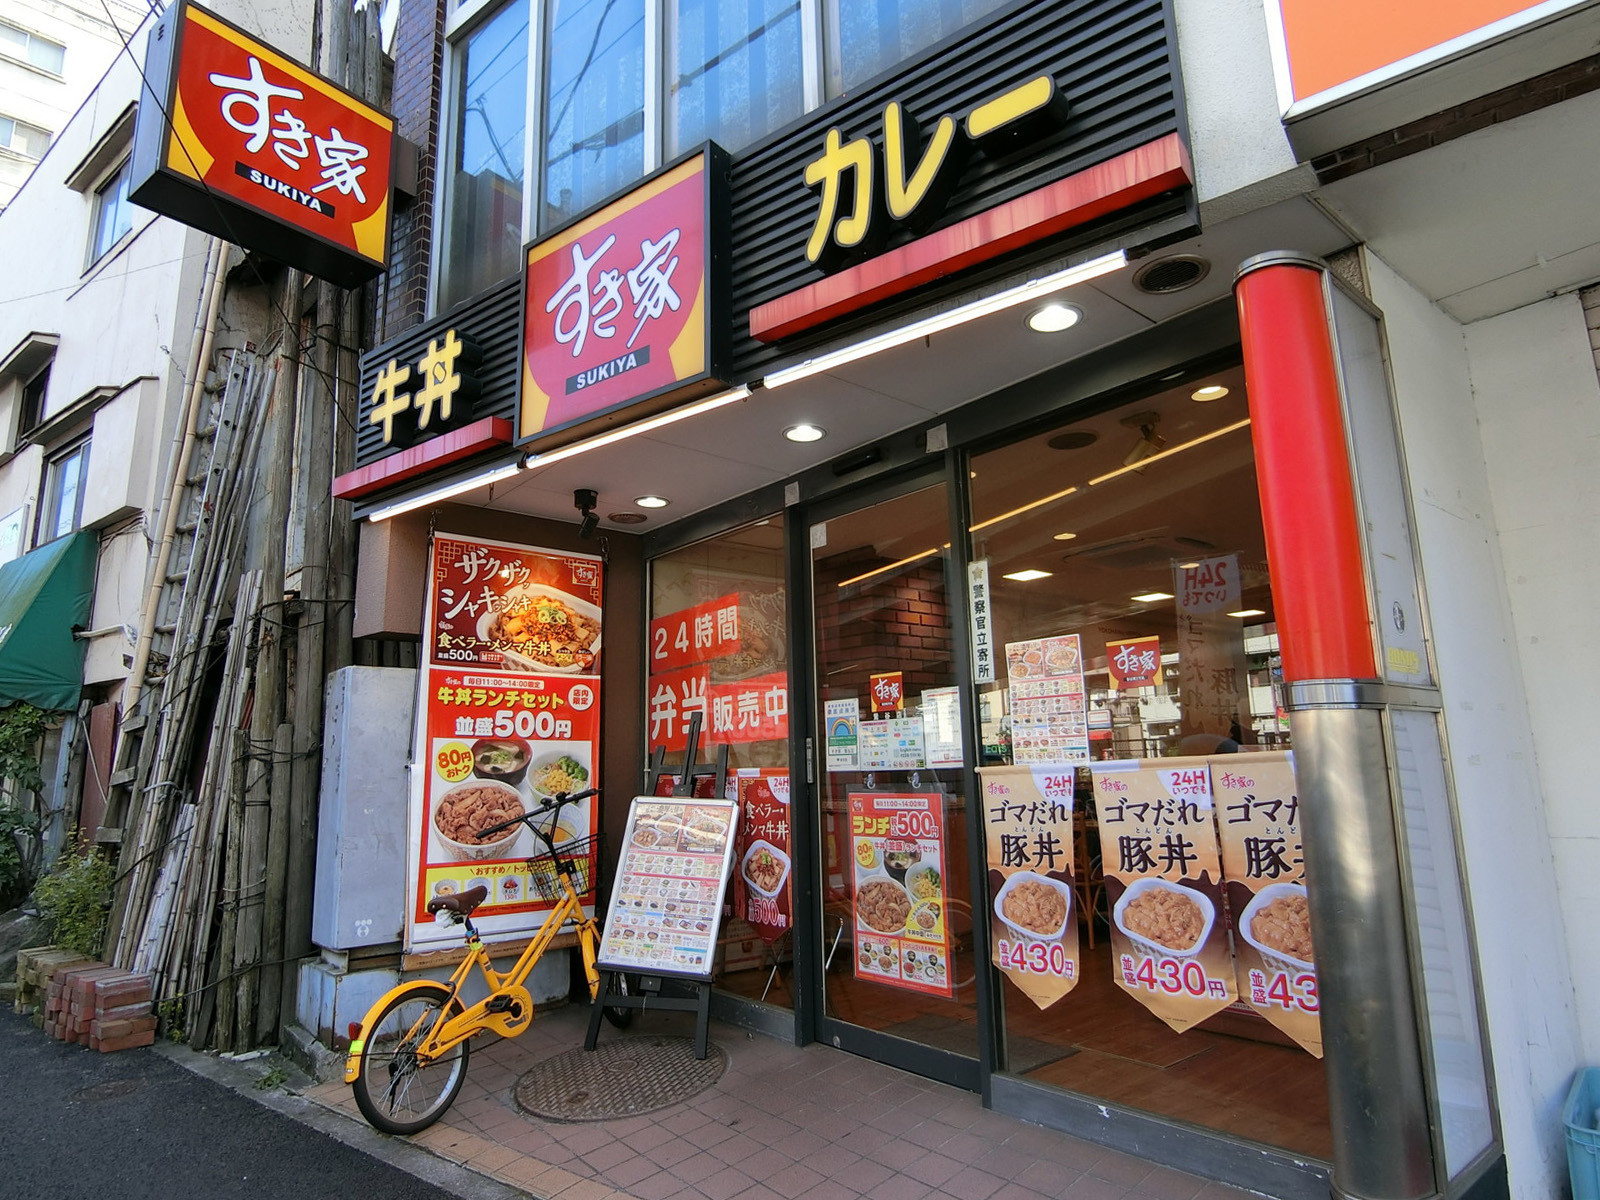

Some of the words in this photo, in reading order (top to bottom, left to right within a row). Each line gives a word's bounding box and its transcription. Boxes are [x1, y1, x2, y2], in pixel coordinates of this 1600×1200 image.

[208, 56, 369, 204] すき家
[803, 73, 1056, 265] カレー
[249, 169, 323, 213] SUKIYA
[545, 227, 682, 358] すき家
[369, 328, 463, 444] 牛丼
[576, 355, 638, 390] SUKIYA
[654, 605, 738, 660] 24時間
[973, 584, 990, 679] 警察官立寄所
[1113, 645, 1156, 675] すき家
[438, 687, 565, 709] 牛丼ランチセット
[874, 678, 900, 701] すき家
[455, 710, 572, 738] 並盛500円
[438, 750, 471, 769] 80円
[446, 765, 470, 778] おトク
[774, 778, 789, 787] 24H
[1044, 775, 1072, 789] 24H
[1171, 770, 1205, 786] 24H
[1172, 785, 1206, 795] いつでも
[1220, 772, 1255, 789] すき家の
[990, 799, 1068, 825] ゴマだれ
[1105, 797, 1205, 826] ゴマだれ
[742, 820, 790, 840] メンマ牛丼
[853, 816, 890, 835] ランチ
[1001, 831, 1064, 869] 豚丼
[1118, 833, 1198, 876] 豚丼
[476, 865, 505, 876] おすすめ
